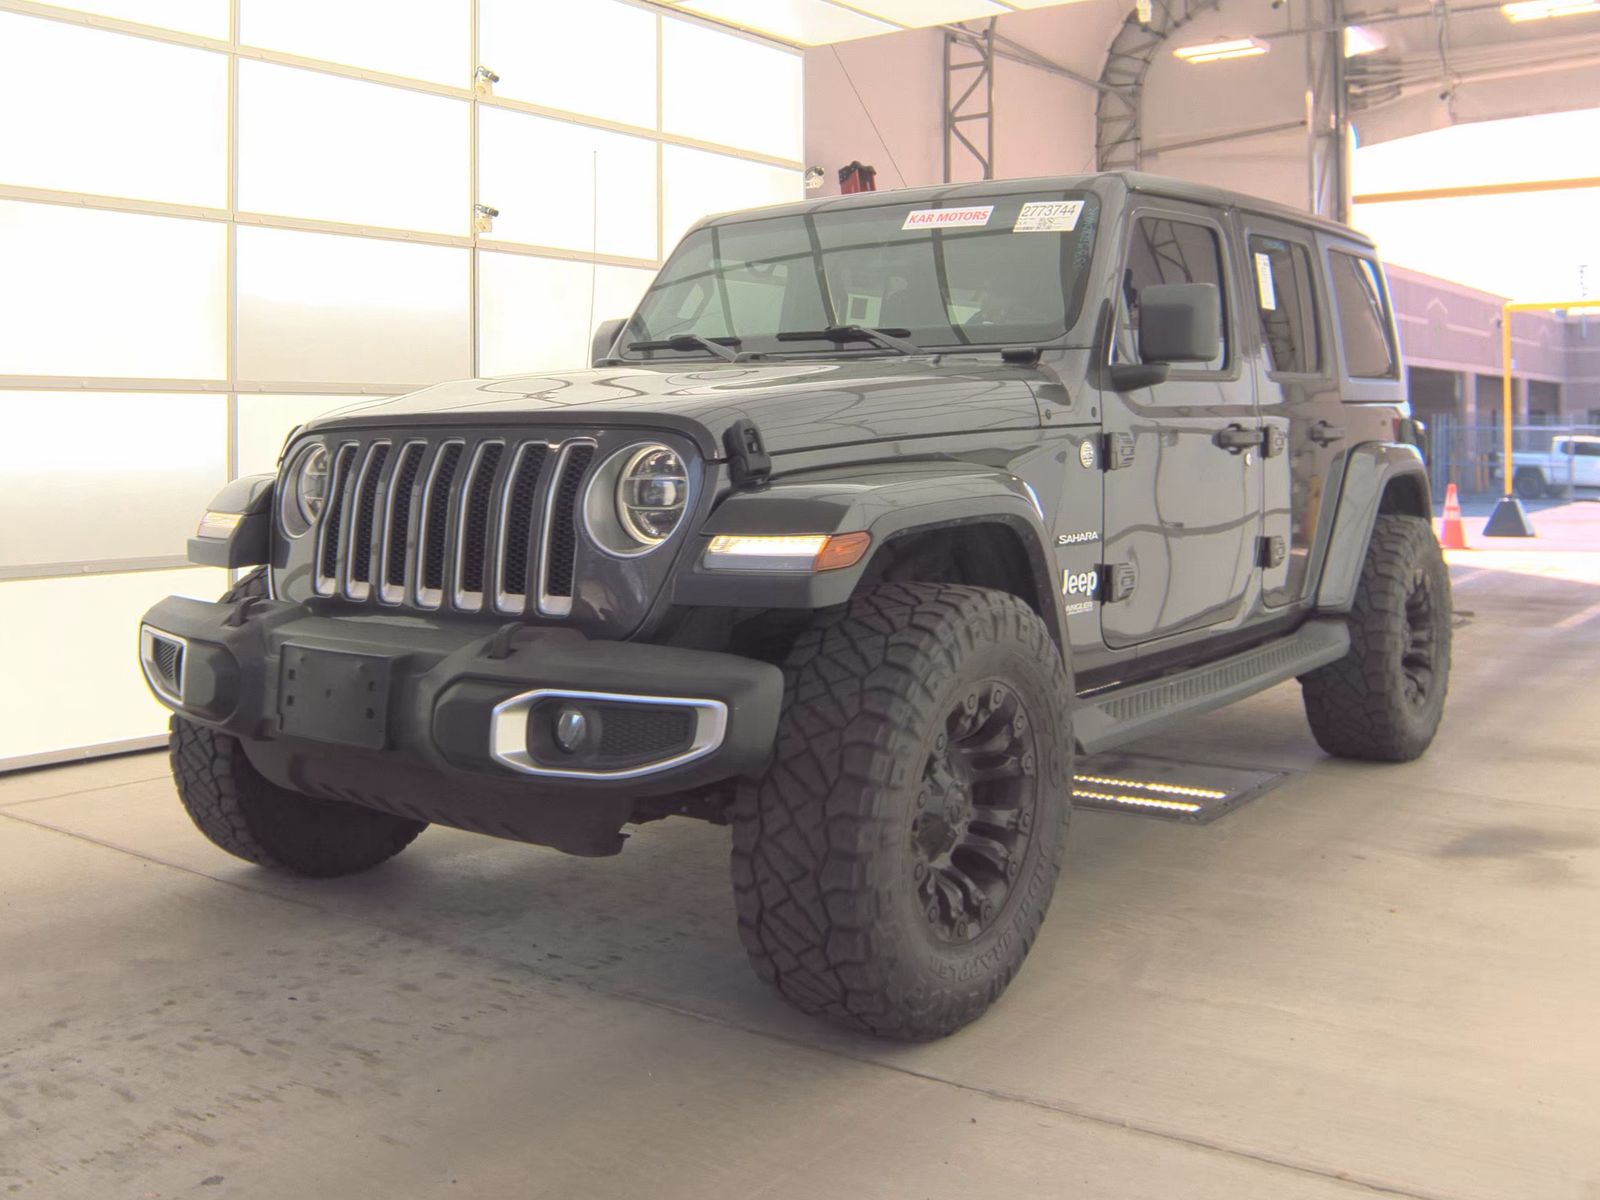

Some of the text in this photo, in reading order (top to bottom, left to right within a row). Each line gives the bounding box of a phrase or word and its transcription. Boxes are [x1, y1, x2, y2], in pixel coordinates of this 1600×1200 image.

[908, 209, 990, 224] KAR MOTORS
[1021, 204, 1077, 217] 2773744
[1058, 531, 1099, 545] SAHARA
[1062, 569, 1098, 597] Jeep
